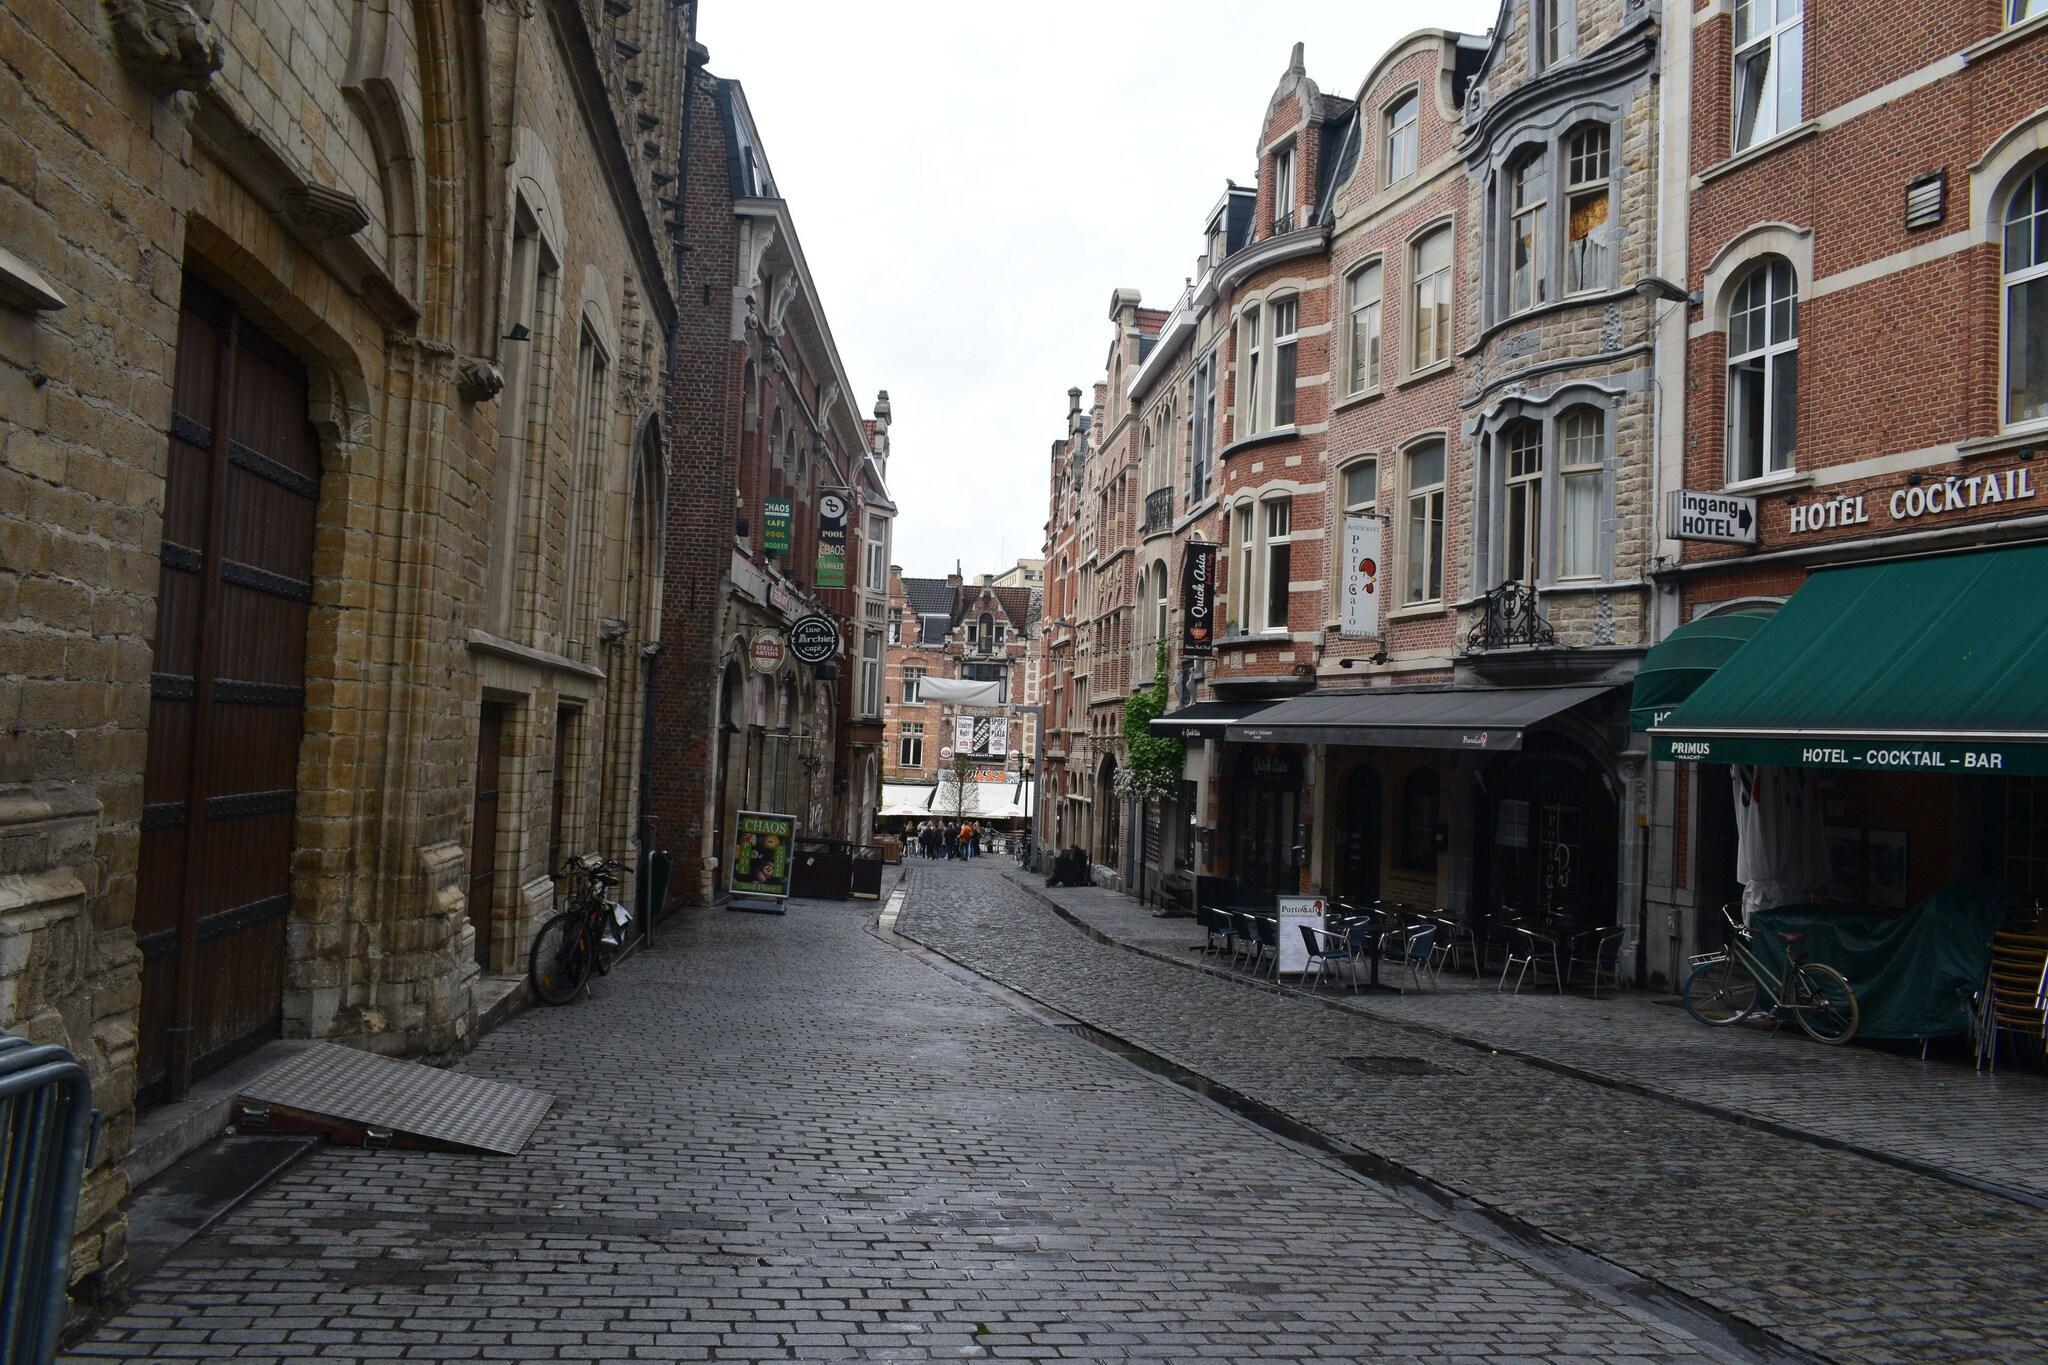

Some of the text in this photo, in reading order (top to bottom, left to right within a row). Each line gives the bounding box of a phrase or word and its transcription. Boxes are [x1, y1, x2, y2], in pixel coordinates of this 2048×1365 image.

[1682, 492, 1738, 519] ingang
[1790, 468, 2036, 534] HOTEL COCKTAIL
[822, 530, 845, 538] POOL
[1682, 516, 1735, 537] HOTEL
[1191, 552, 1208, 618] Quick Asia
[1671, 742, 1710, 755] PRIMUS
[1802, 748, 1849, 764] HOTEL
[1866, 750, 1945, 767] COCKTAIL
[1964, 752, 2003, 769] BAR
[745, 819, 787, 834] CHAOS
